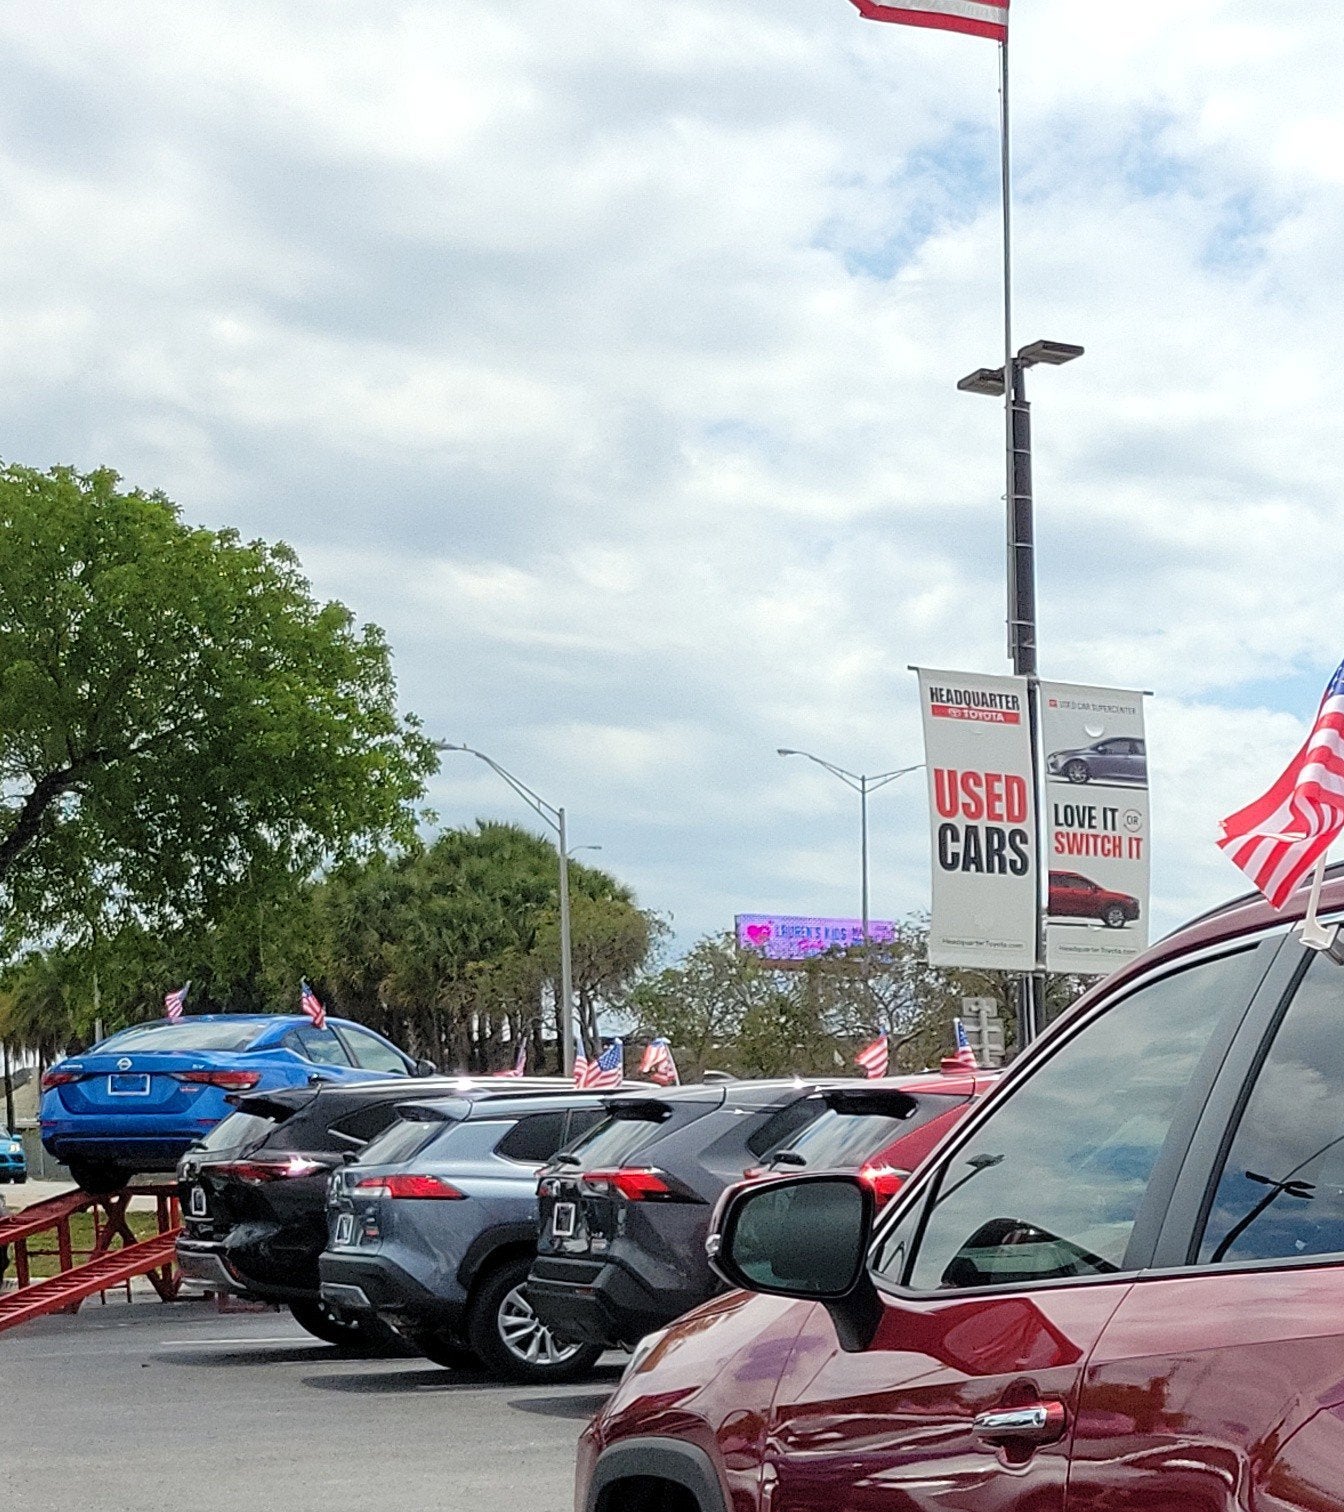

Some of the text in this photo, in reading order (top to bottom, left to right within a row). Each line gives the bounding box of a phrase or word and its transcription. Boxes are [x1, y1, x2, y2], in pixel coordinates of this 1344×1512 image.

[929, 686, 1020, 711] HEADQUARTER
[963, 709, 1004, 723] TOYOTA
[933, 768, 1028, 823] USED
[1053, 803, 1139, 832] LOVE IT OR
[938, 822, 1029, 876] CARS
[1054, 831, 1144, 860] SWITCH IT
